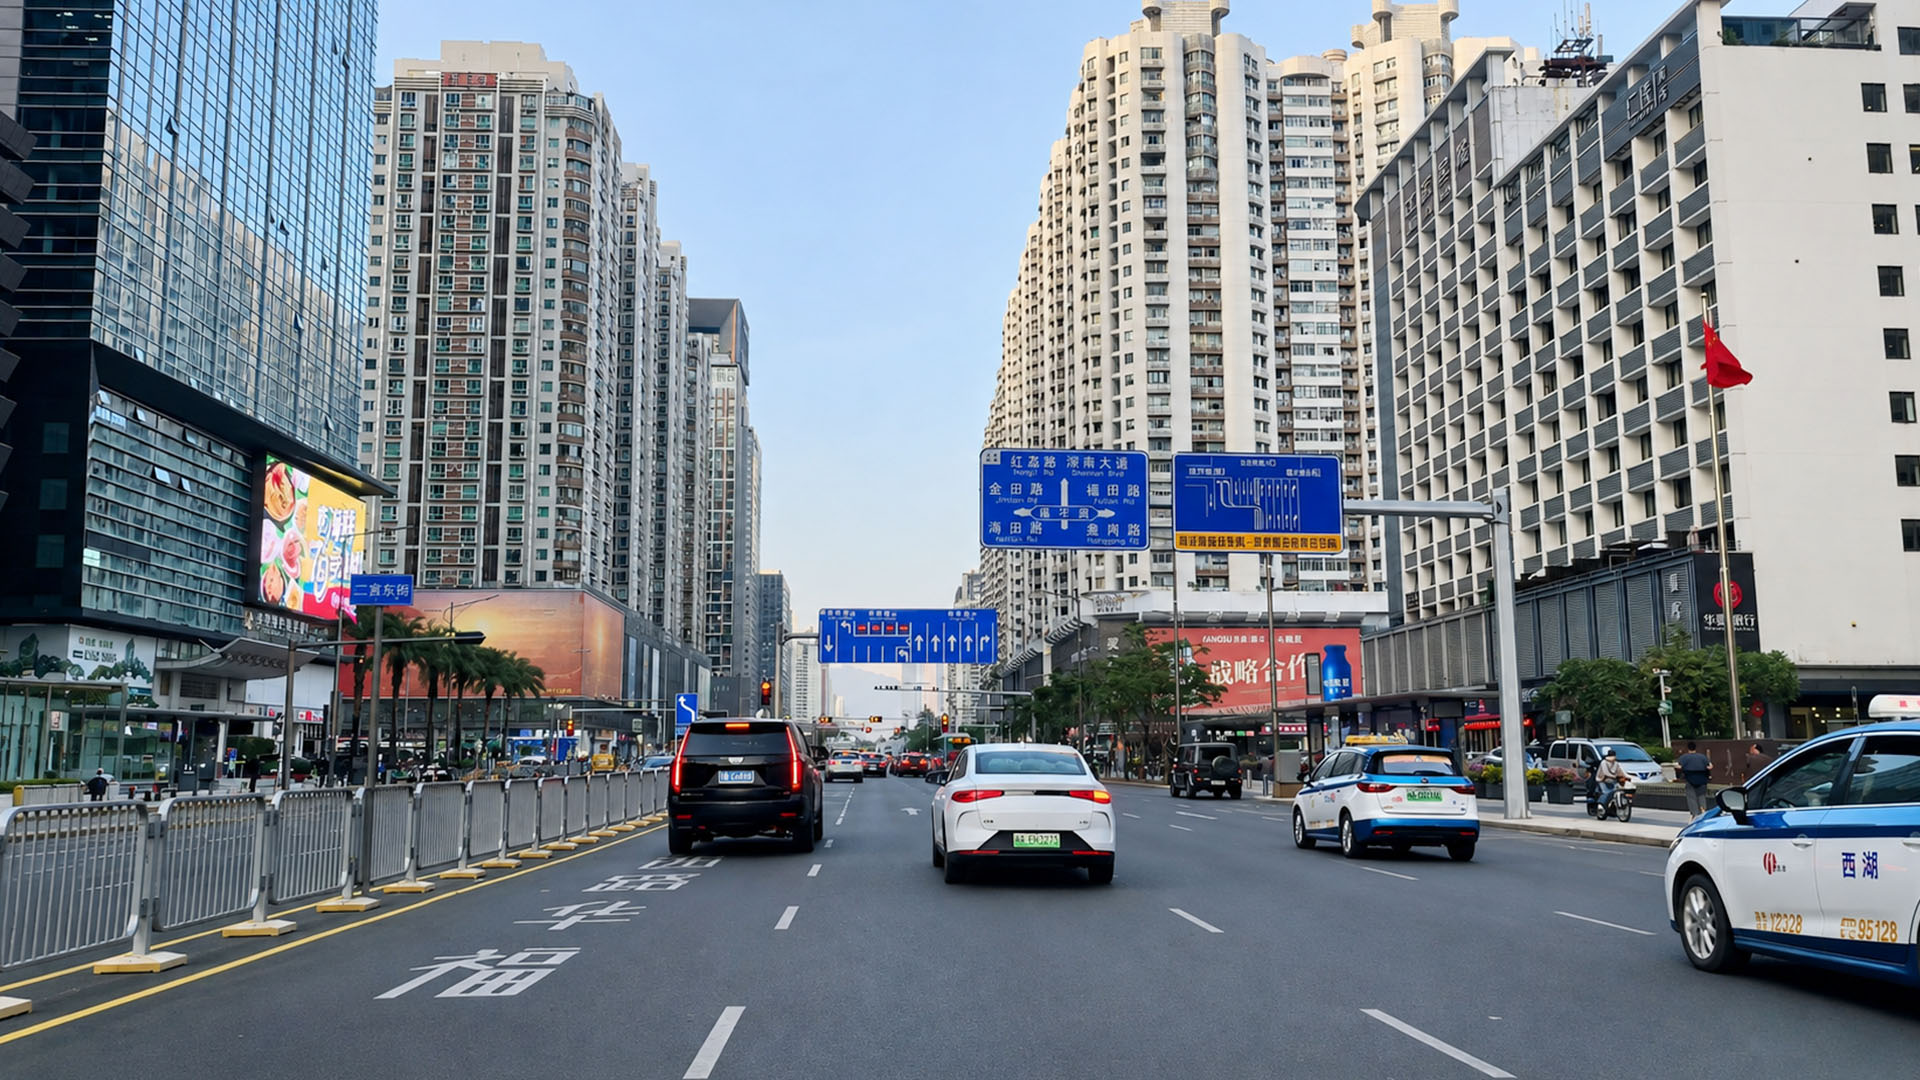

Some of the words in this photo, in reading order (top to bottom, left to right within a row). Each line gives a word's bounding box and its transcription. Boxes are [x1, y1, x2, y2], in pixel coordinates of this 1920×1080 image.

[989, 482, 1043, 496] 金田路
[1086, 483, 1140, 497] 福田路
[1841, 850, 1879, 880] 西湖
[1857, 917, 1899, 944] 95128
